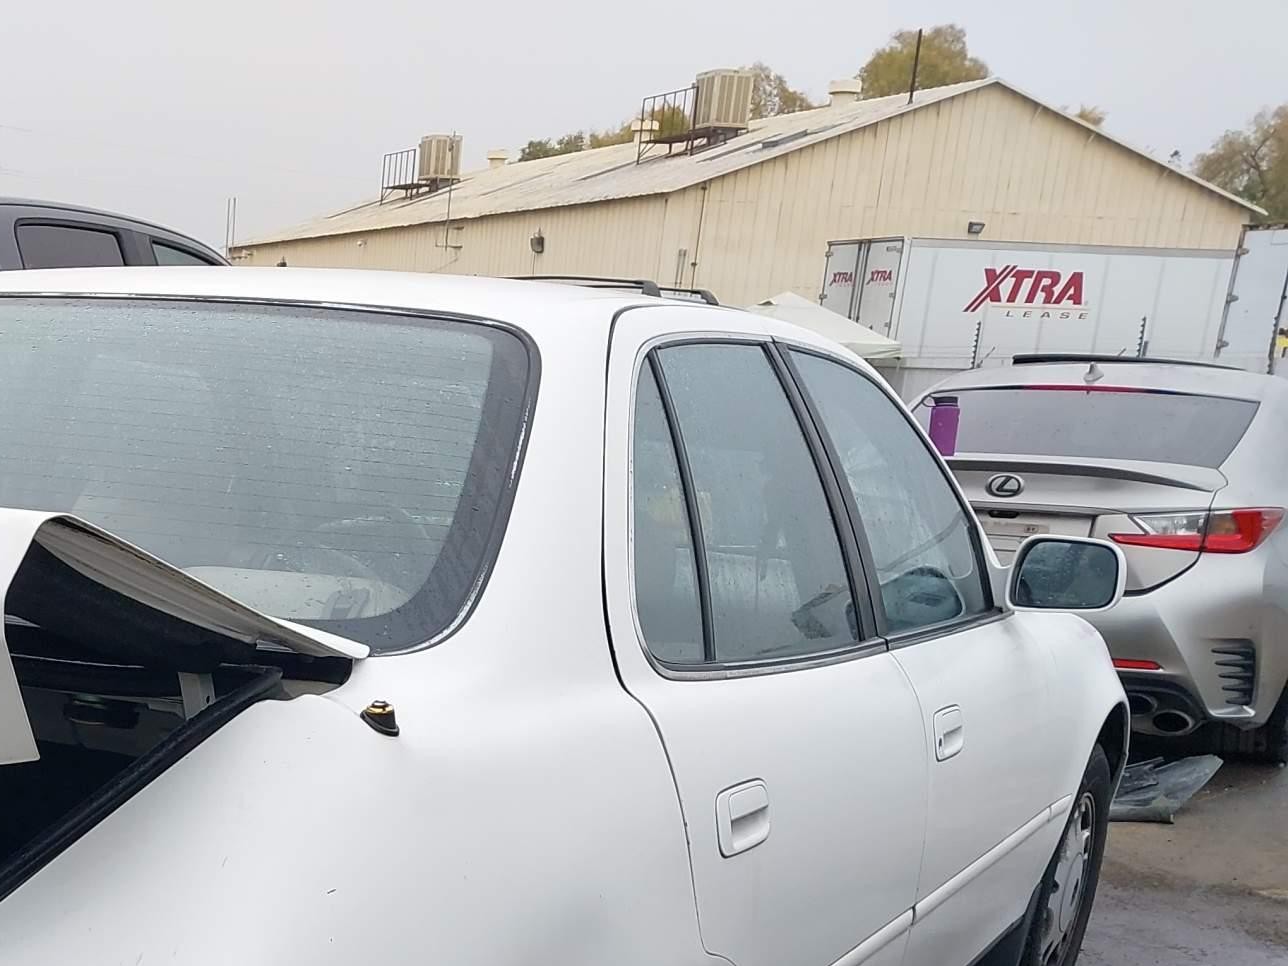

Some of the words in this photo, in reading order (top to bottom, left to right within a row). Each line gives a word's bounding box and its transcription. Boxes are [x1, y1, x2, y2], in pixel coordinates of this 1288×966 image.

[829, 271, 854, 287] XTRA
[866, 270, 893, 286] XTRA
[962, 264, 1084, 312] XTRA
[1005, 310, 1089, 320] LEASE
